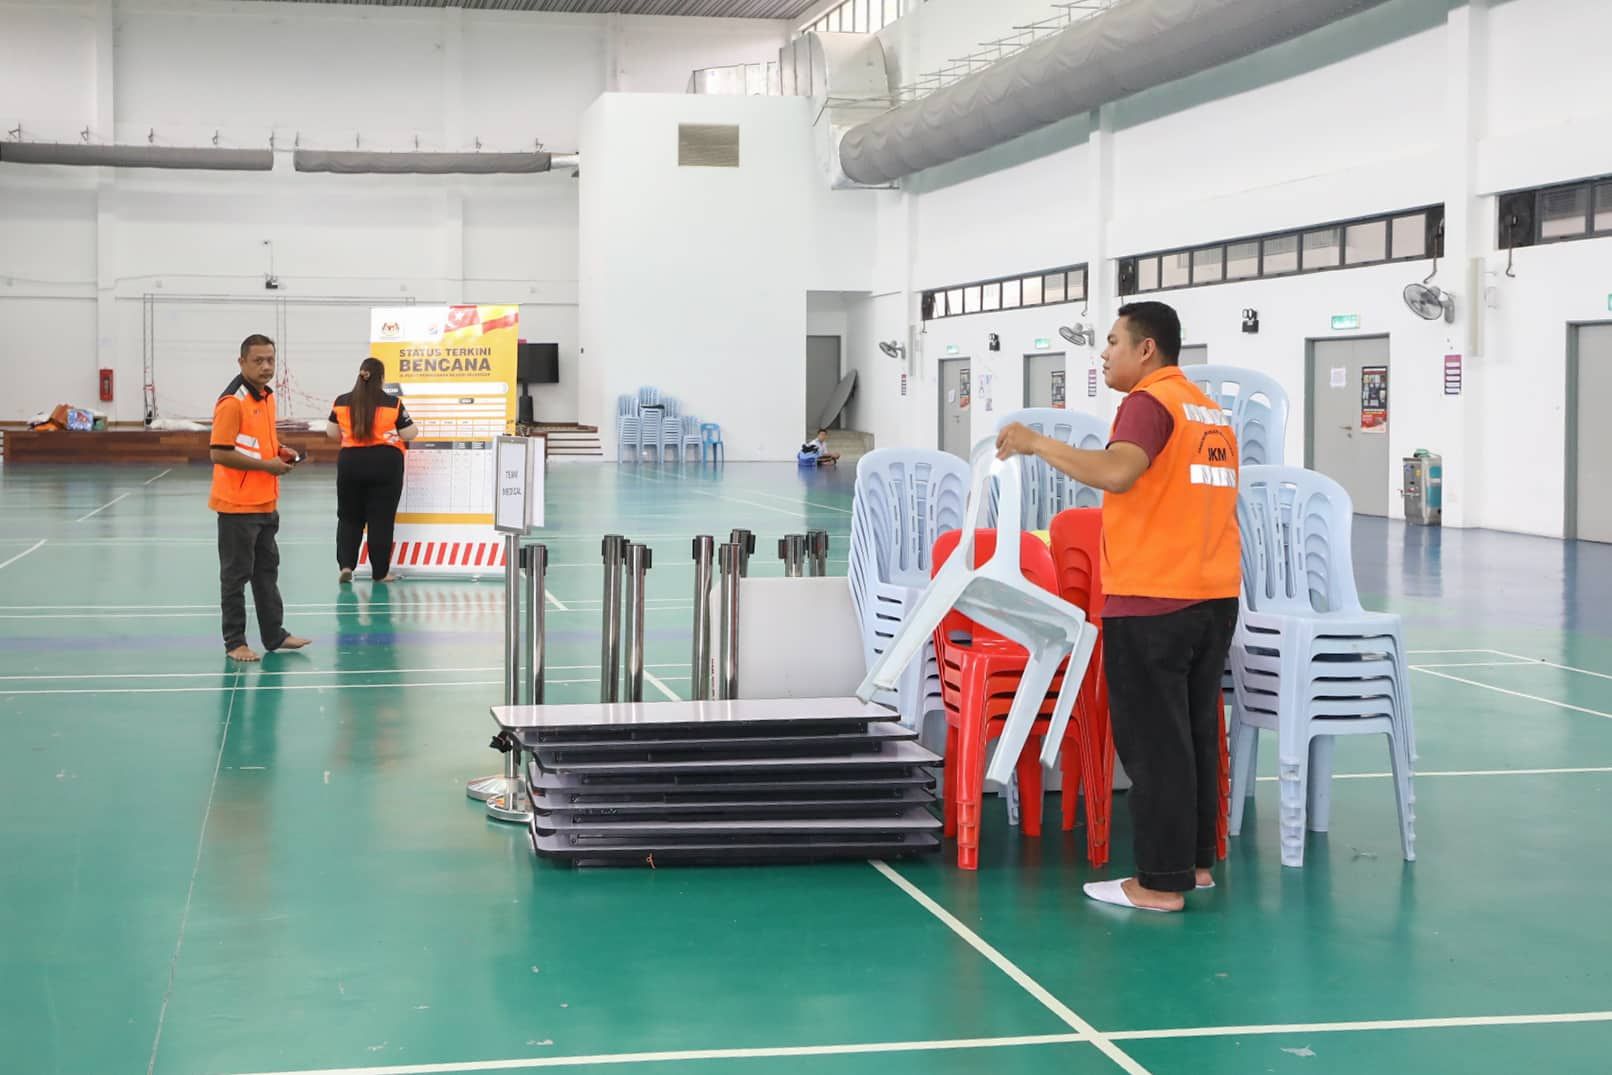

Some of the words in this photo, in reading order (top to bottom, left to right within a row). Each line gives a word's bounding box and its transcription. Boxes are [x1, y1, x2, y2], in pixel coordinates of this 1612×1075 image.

[399, 348, 442, 357] STATUS
[446, 347, 492, 356] TERKINI
[399, 358, 492, 372] BENCANA
[1208, 447, 1227, 462] JKM
[502, 487, 522, 496] MEDICAL
